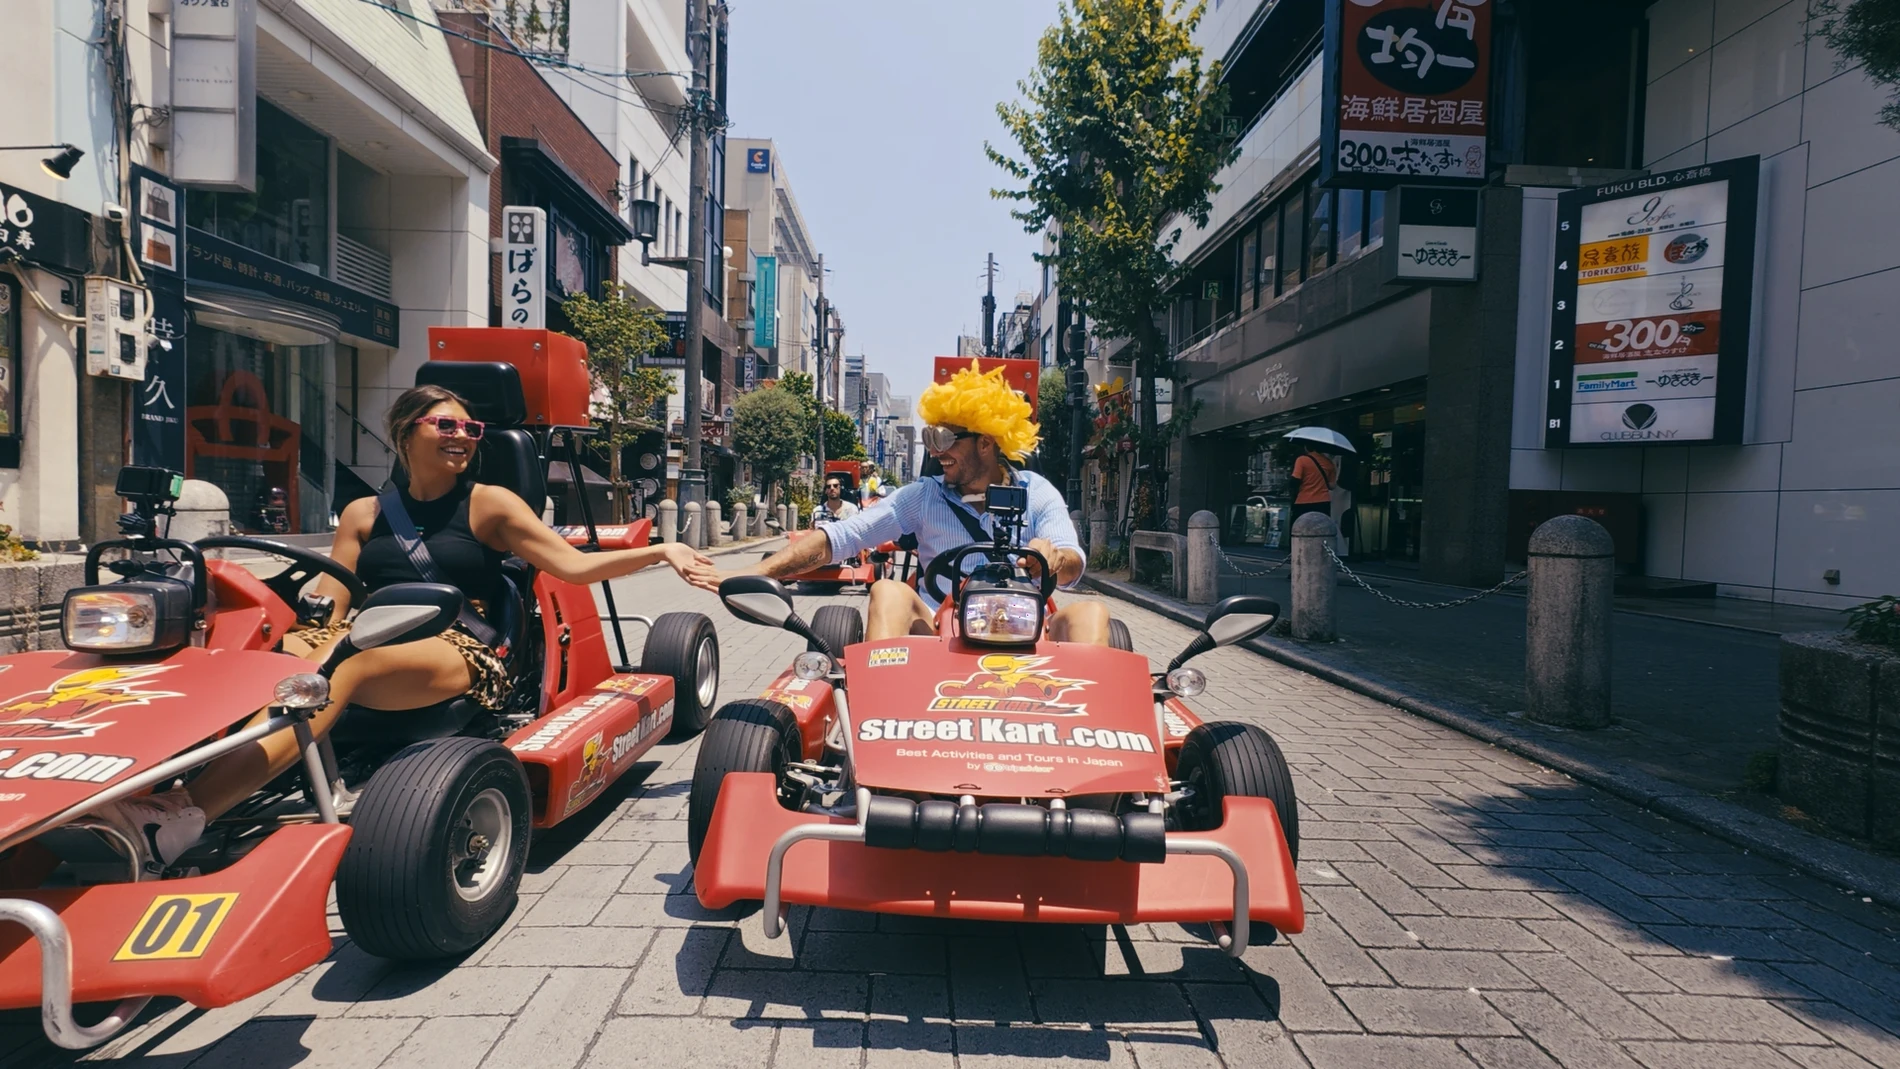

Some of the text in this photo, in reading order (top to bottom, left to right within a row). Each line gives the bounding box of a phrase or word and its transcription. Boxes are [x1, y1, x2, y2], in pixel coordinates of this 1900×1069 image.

[1366, 25, 1475, 79] 均一
[1341, 95, 1485, 126] 海鮮居酒屋
[1597, 181, 1634, 197] FUKU
[1638, 175, 1670, 189] BLD.
[1561, 221, 1570, 231] 5
[1414, 247, 1460, 267] ゆきざき
[1582, 242, 1640, 267] 鳥貴族
[1558, 261, 1568, 271] 4
[1581, 264, 1640, 278] TORIKIZOKU
[508, 247, 537, 327] ばらの
[1557, 301, 1566, 310] 3
[1554, 341, 1564, 350] 2
[1553, 380, 1560, 389] 1
[1578, 379, 1636, 391] FamilyMart
[1549, 419, 1561, 429] B1
[612, 721, 641, 764] Street
[859, 717, 1156, 753] Street Kart .com
[896, 748, 1123, 768] Best Activities and Tours in Japan
[966, 761, 980, 771] by
[131, 897, 226, 956] 01
